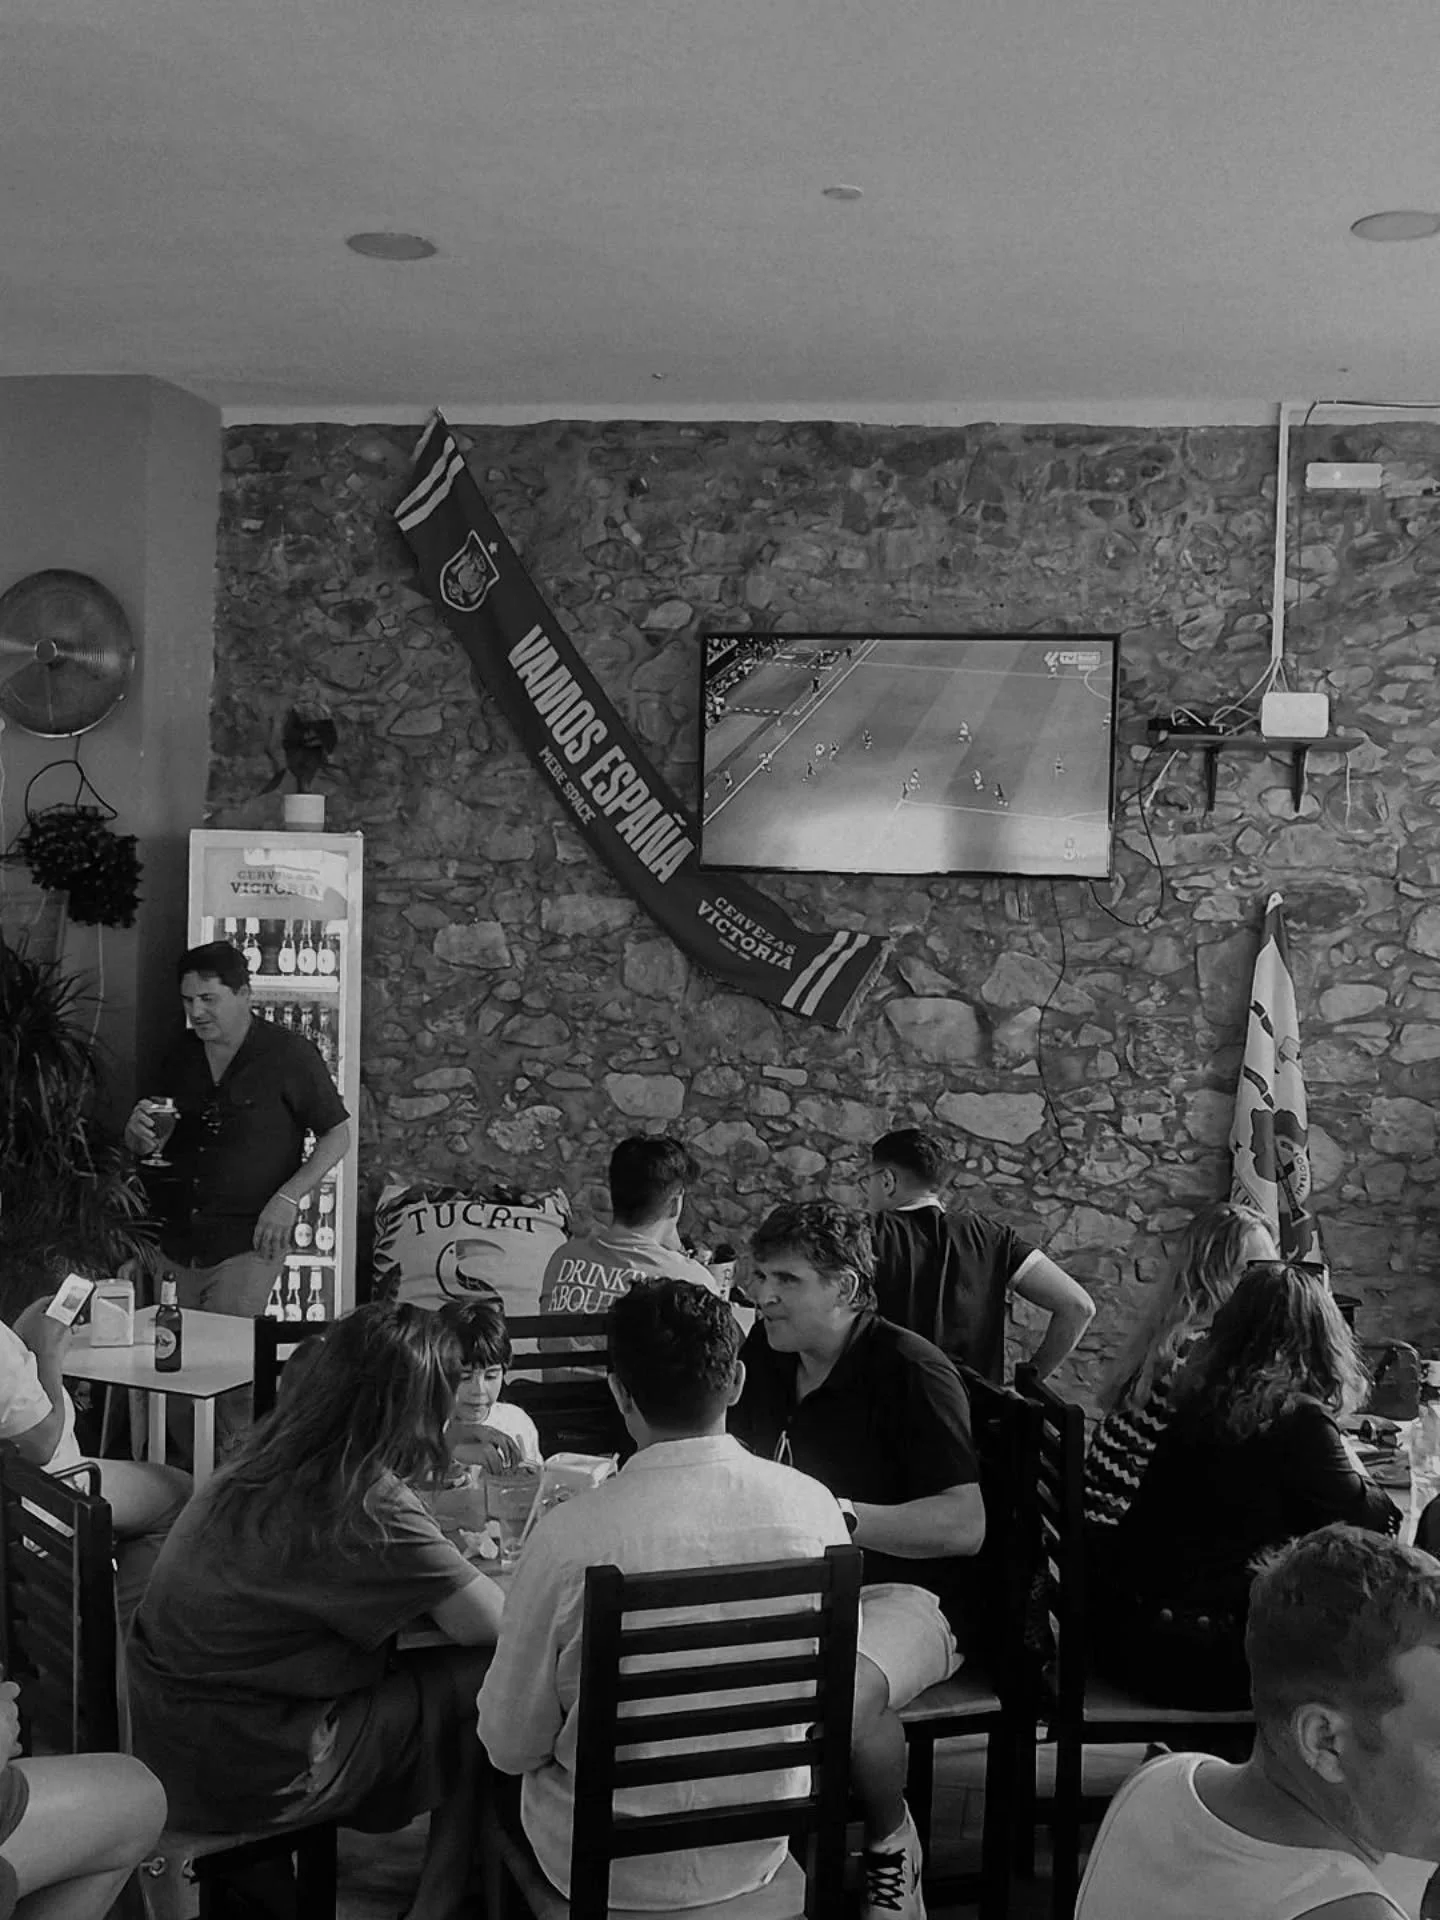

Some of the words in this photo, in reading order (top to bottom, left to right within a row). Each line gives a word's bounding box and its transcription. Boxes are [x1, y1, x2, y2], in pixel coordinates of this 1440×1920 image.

[508, 624, 608, 764] VAMOS
[580, 745, 695, 884] ESPAÑA
[562, 781, 597, 825] SPACE
[237, 870, 314, 881] CERV
[696, 899, 794, 972] VICTORIA
[714, 896, 799, 955] CERVEZAS
[548, 1284, 625, 1314] ABOUT
